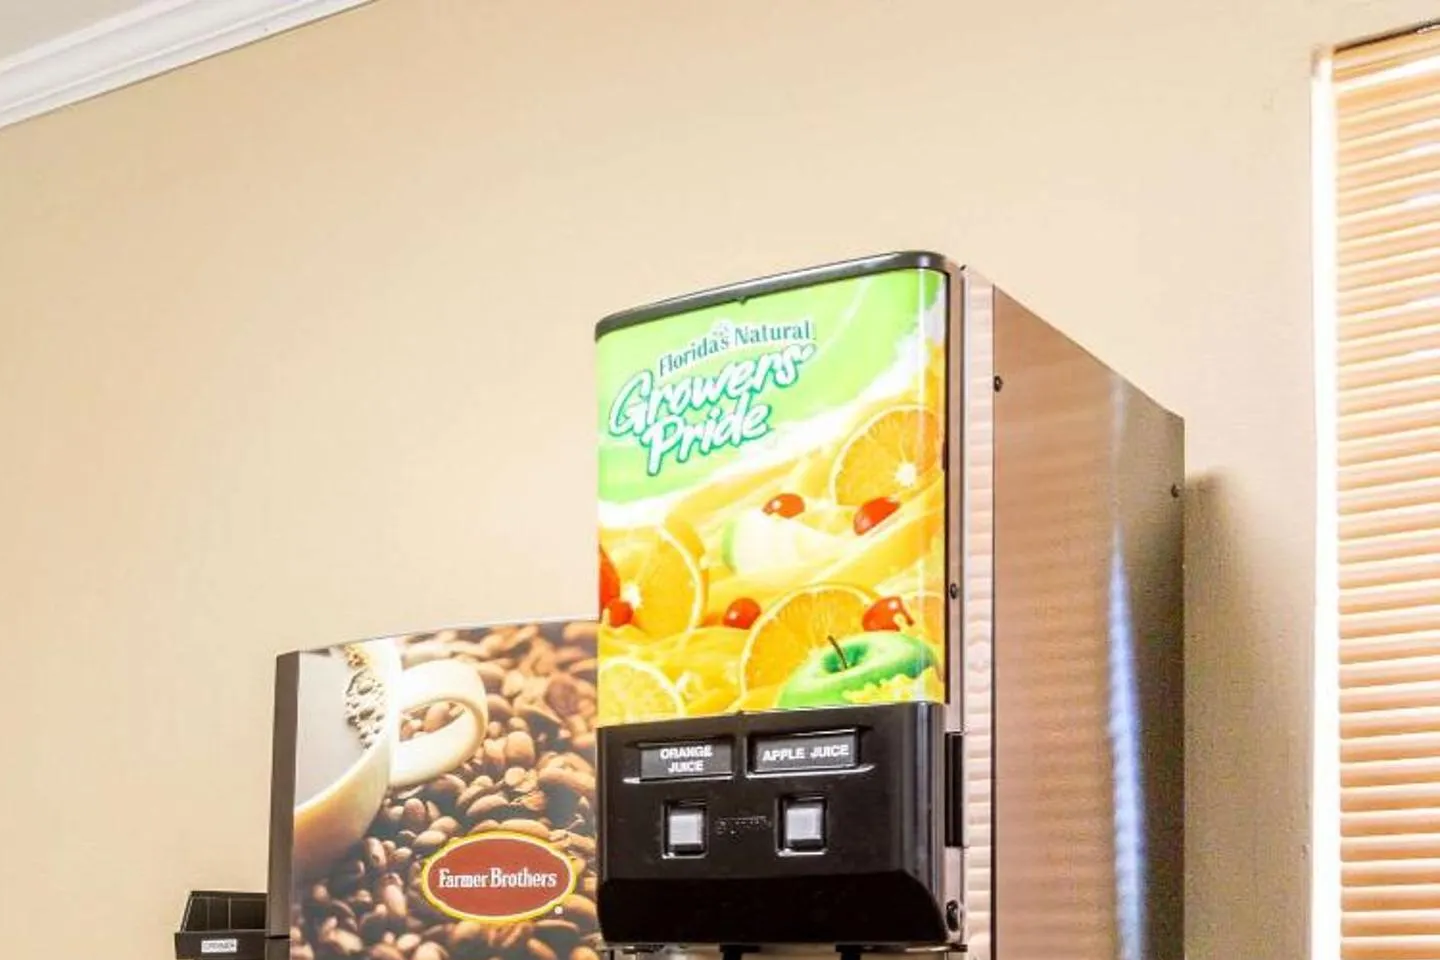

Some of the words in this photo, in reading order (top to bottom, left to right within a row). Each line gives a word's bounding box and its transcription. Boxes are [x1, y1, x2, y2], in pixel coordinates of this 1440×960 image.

[735, 320, 810, 345] Natural
[639, 391, 774, 477] Pride
[660, 745, 712, 760] ORANGE
[762, 749, 806, 762] APPLE
[810, 744, 849, 758] JUICE
[668, 760, 704, 773] JUICE
[438, 867, 488, 889] Farmer
[490, 866, 558, 888] Brothers
